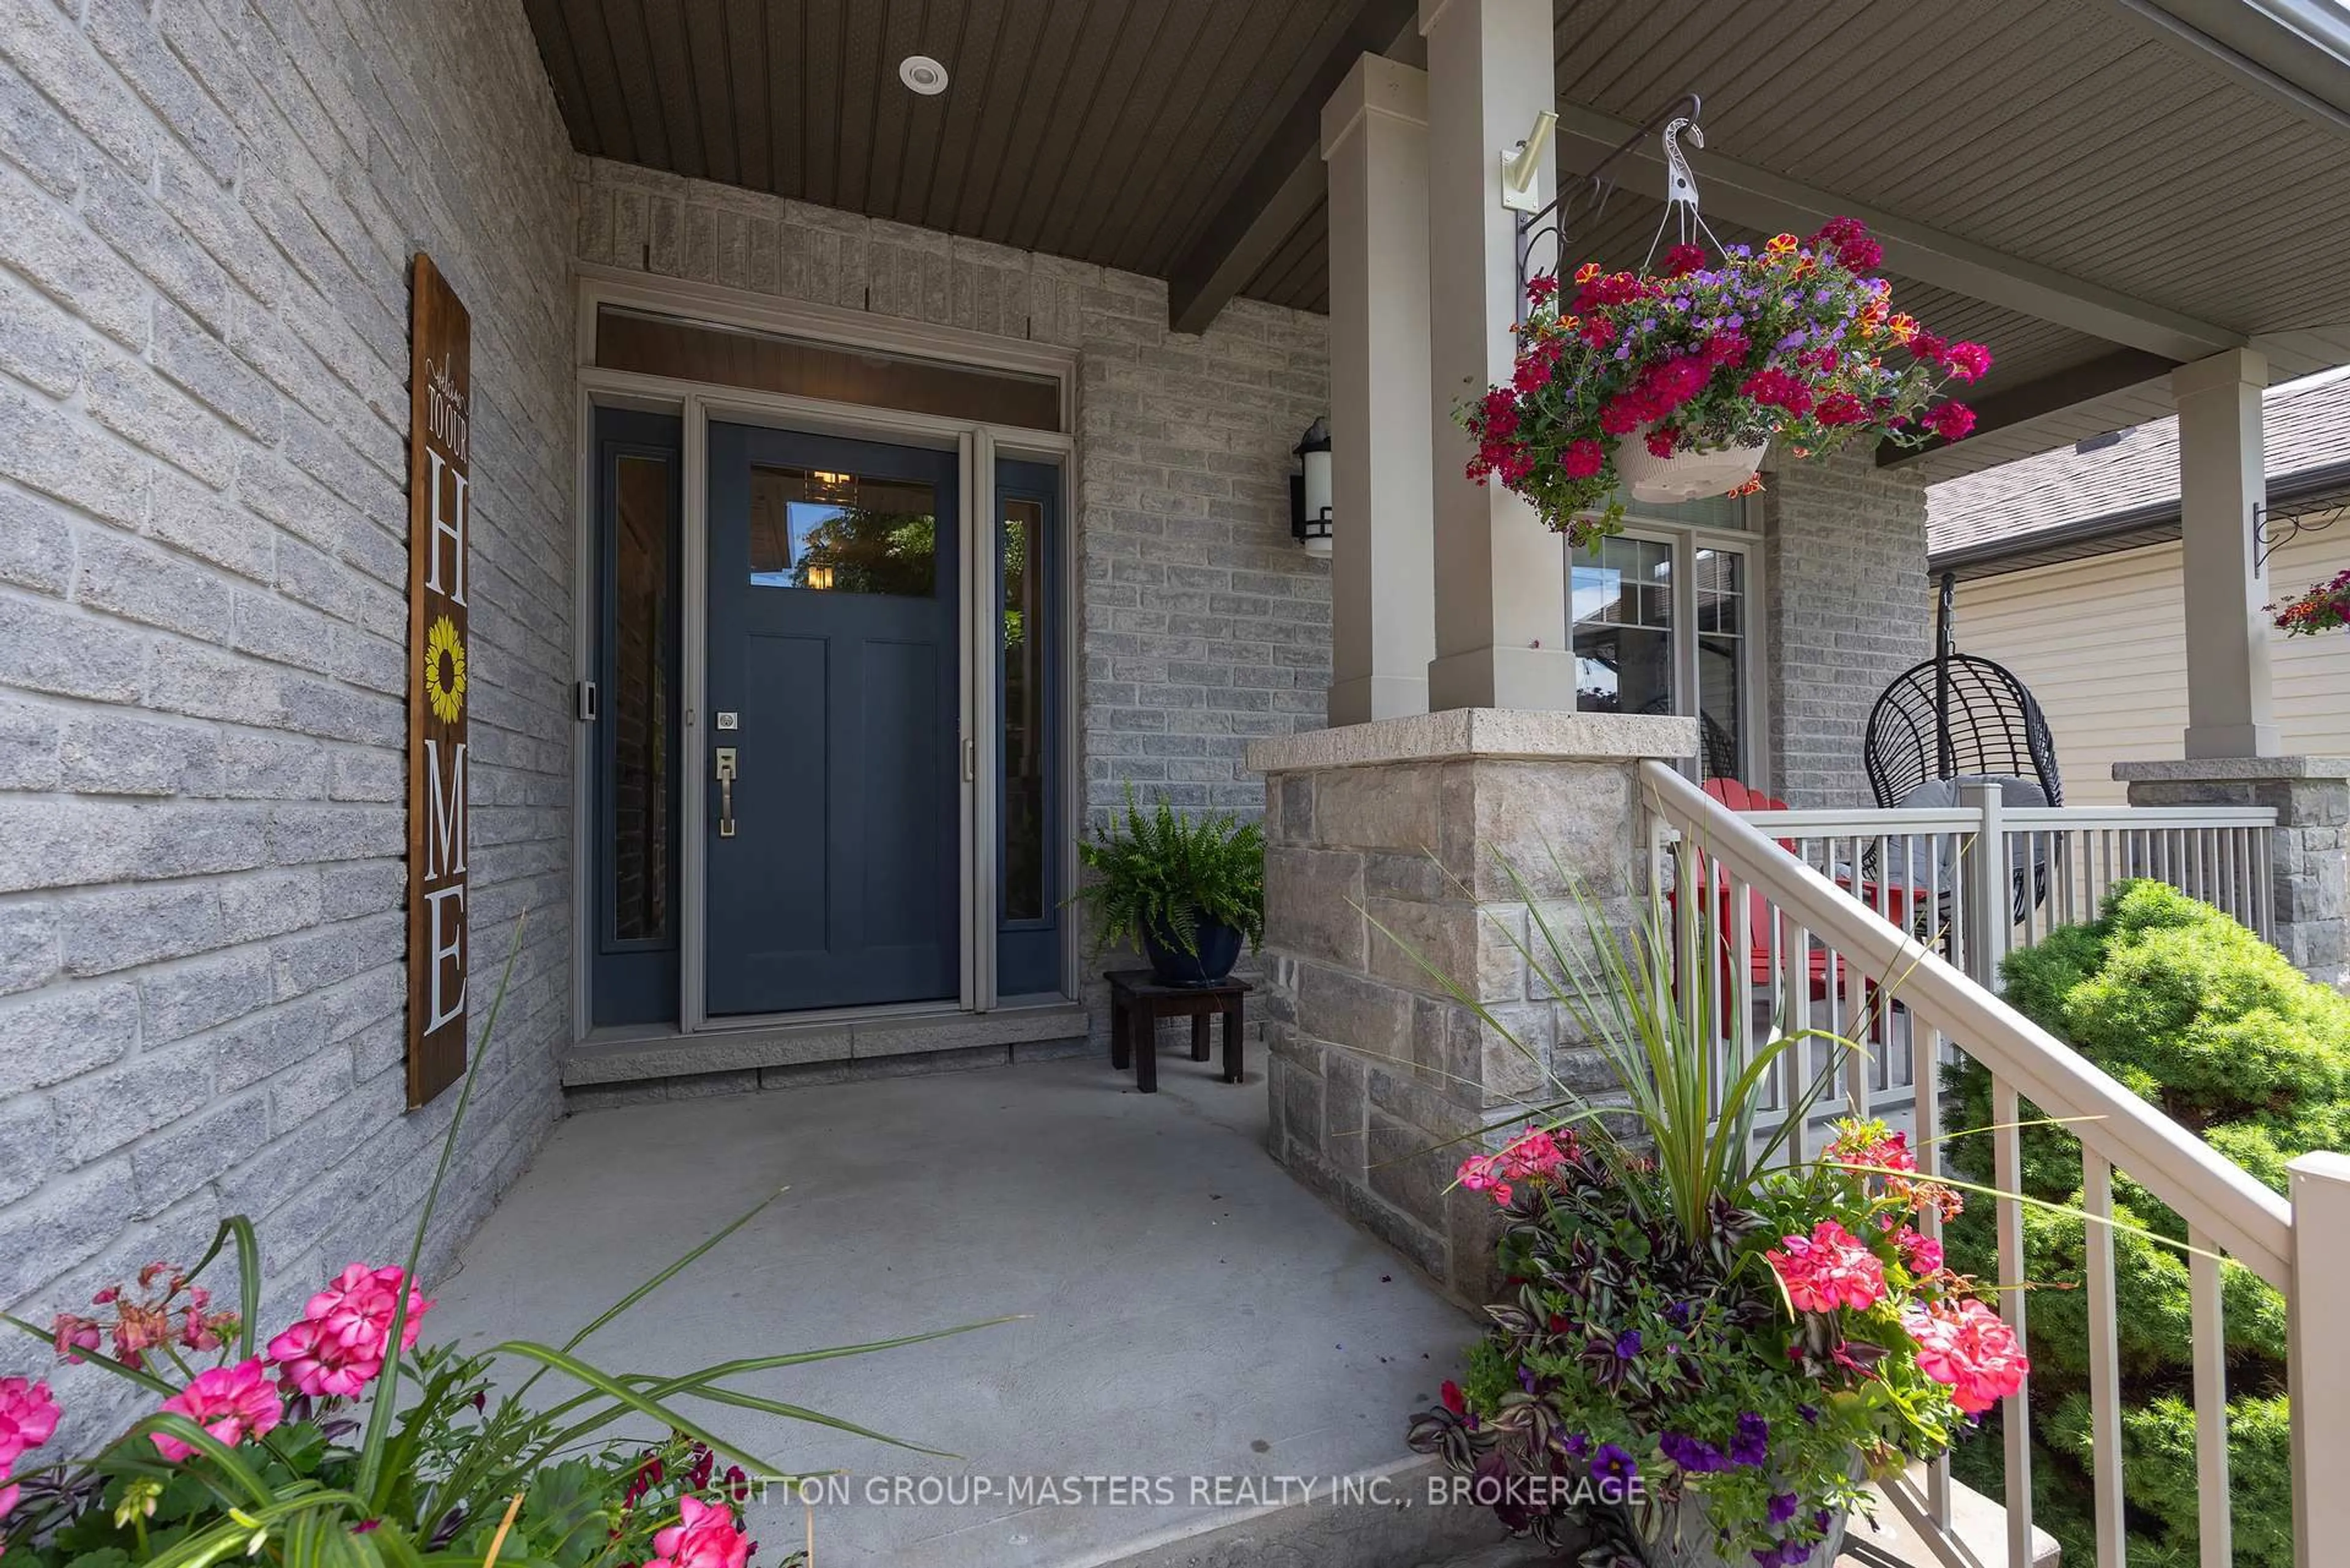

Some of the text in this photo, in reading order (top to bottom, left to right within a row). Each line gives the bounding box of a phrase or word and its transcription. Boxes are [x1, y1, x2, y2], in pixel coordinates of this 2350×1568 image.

[428, 384, 467, 463] TO OUR
[425, 446, 467, 1036] HME
